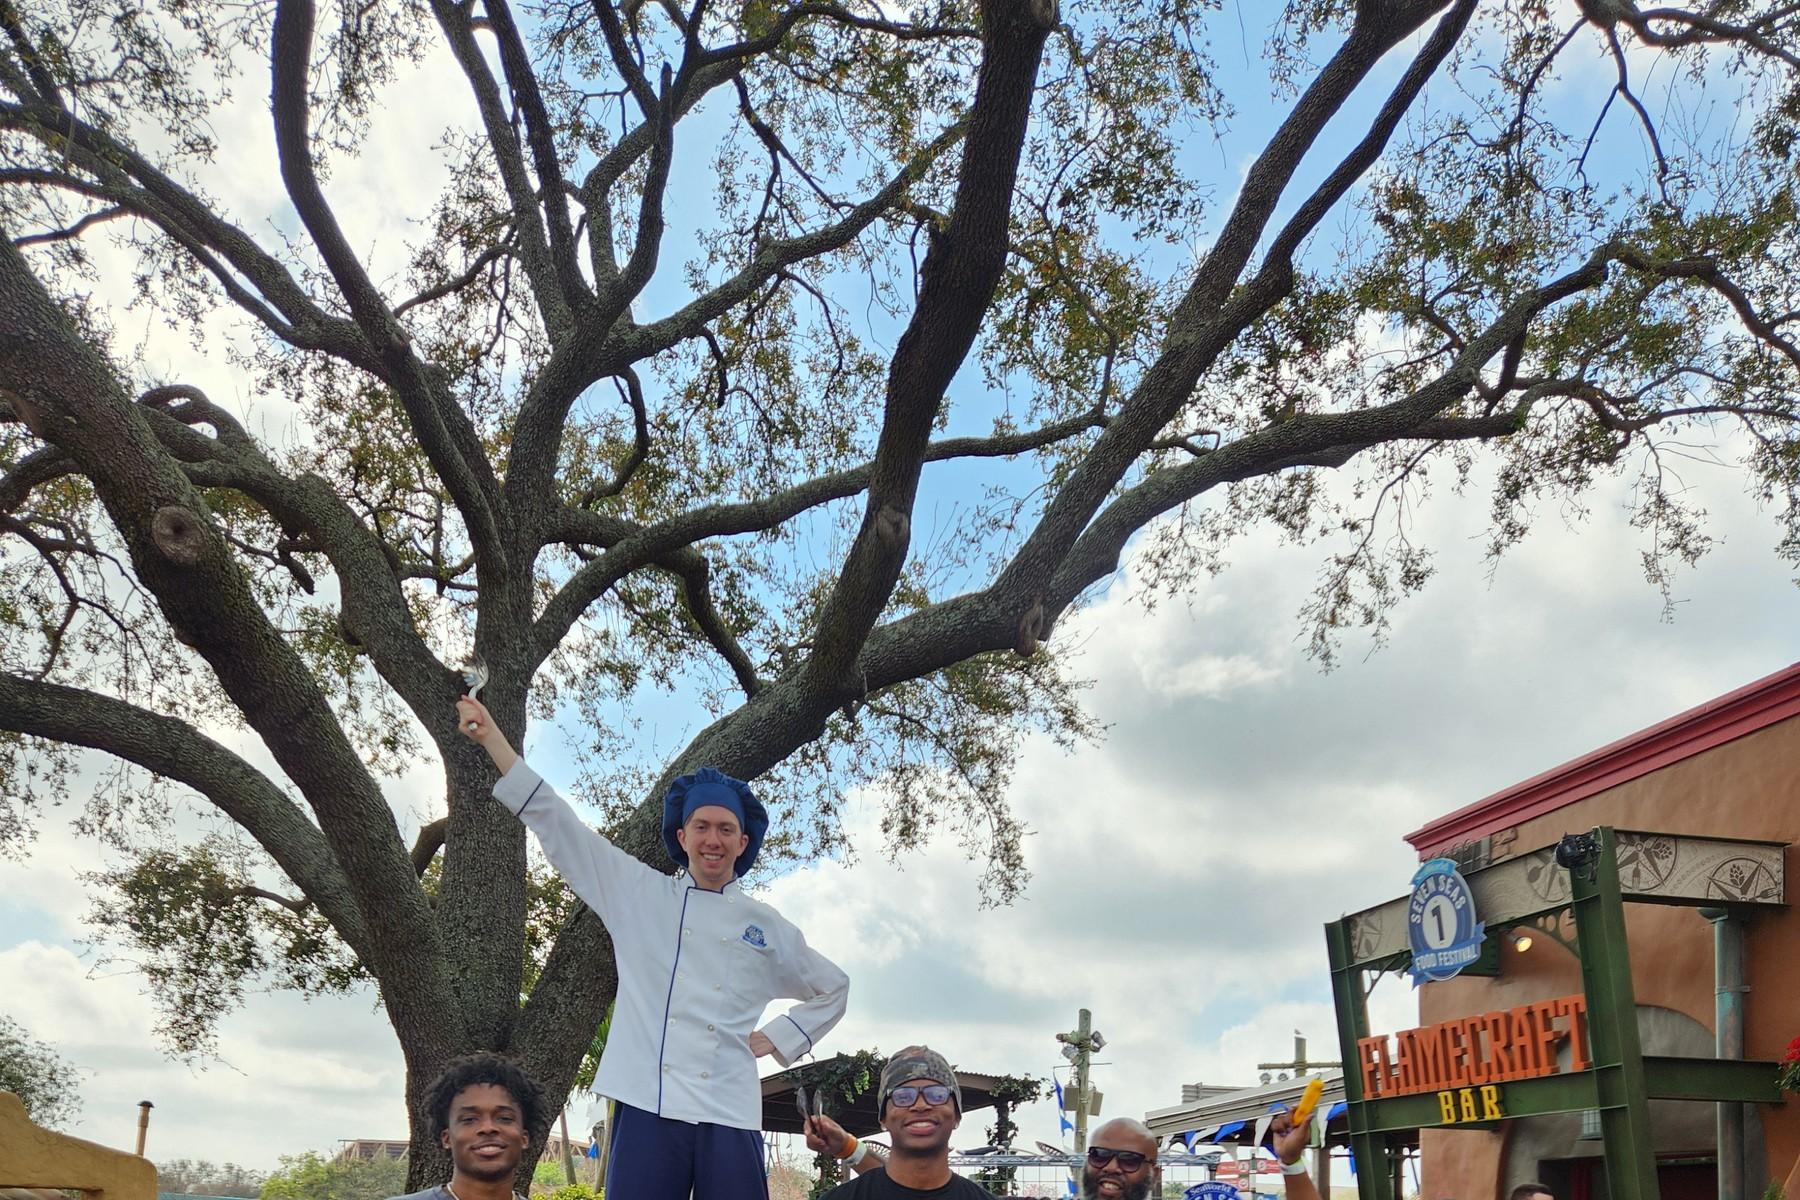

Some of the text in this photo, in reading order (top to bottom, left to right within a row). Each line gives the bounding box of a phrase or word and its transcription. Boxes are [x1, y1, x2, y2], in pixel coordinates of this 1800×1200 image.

[1411, 874, 1466, 924] SEVEN SEAS
[1431, 903, 1445, 942] 1
[1416, 944, 1478, 971] FOOD FESTIVAL
[1358, 993, 1592, 1100] FLAMECRAFT
[1438, 1085, 1502, 1124] BAR
[1190, 1183, 1232, 1196] SeaWorld
